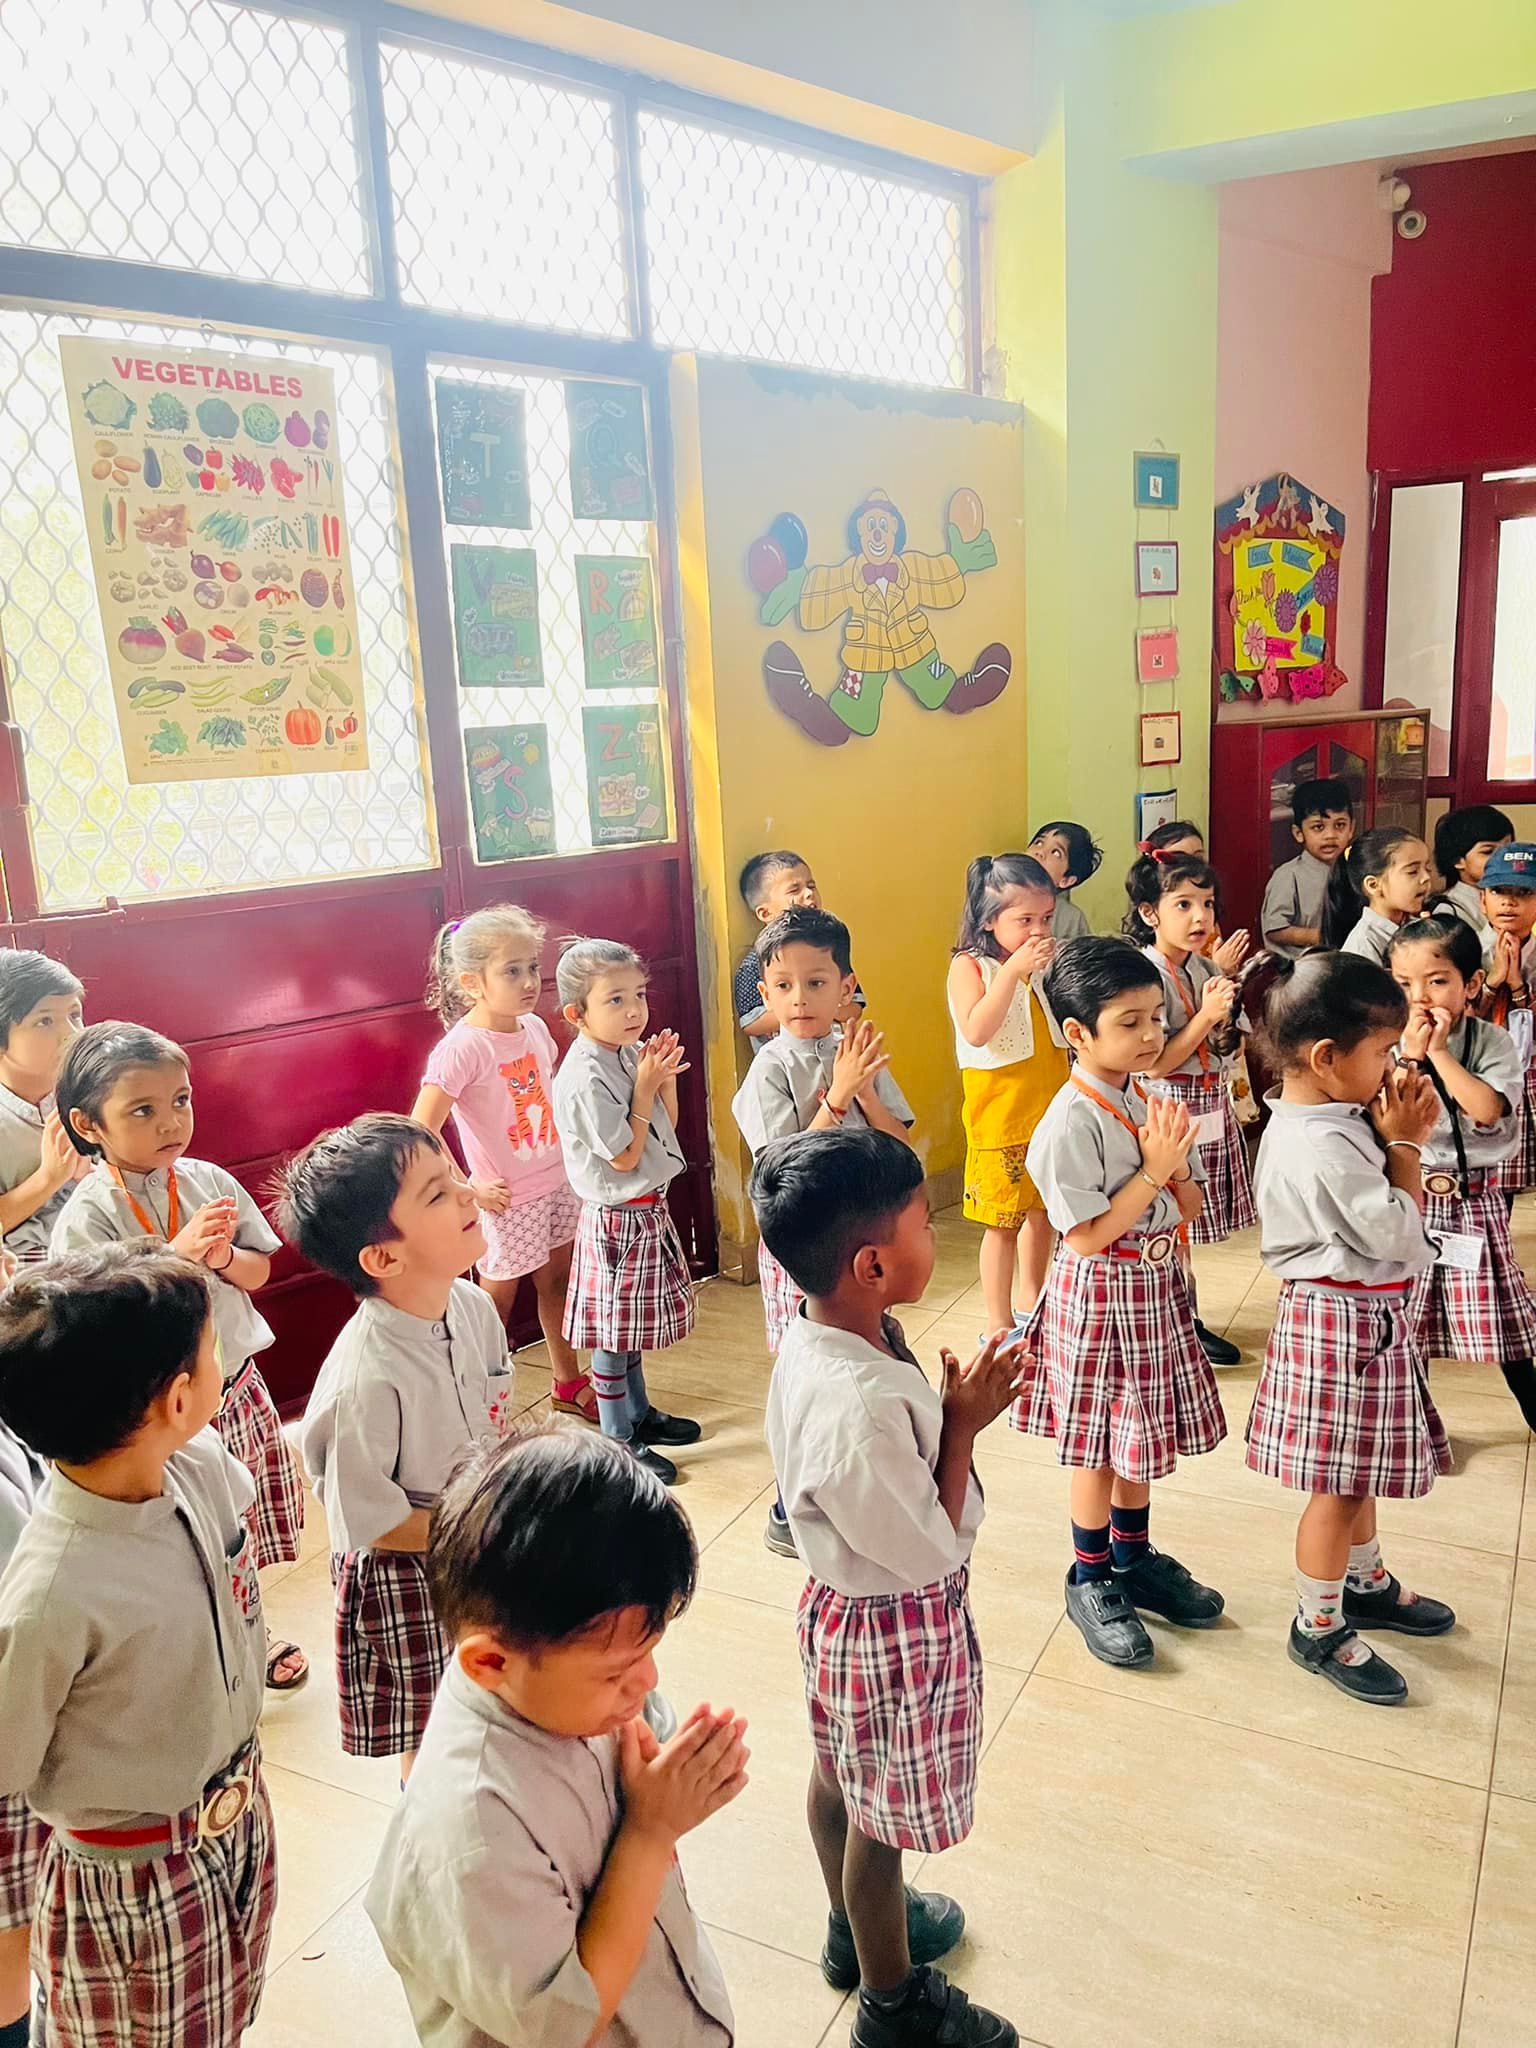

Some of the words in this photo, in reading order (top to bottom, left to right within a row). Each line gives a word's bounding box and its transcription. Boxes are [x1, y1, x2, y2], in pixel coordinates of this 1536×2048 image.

[111, 356, 303, 399] VEGETABLES
[469, 432, 501, 480] T
[588, 567, 614, 615] R
[597, 721, 634, 762] Z
[503, 764, 529, 821] S
[1503, 852, 1534, 861] BEN
